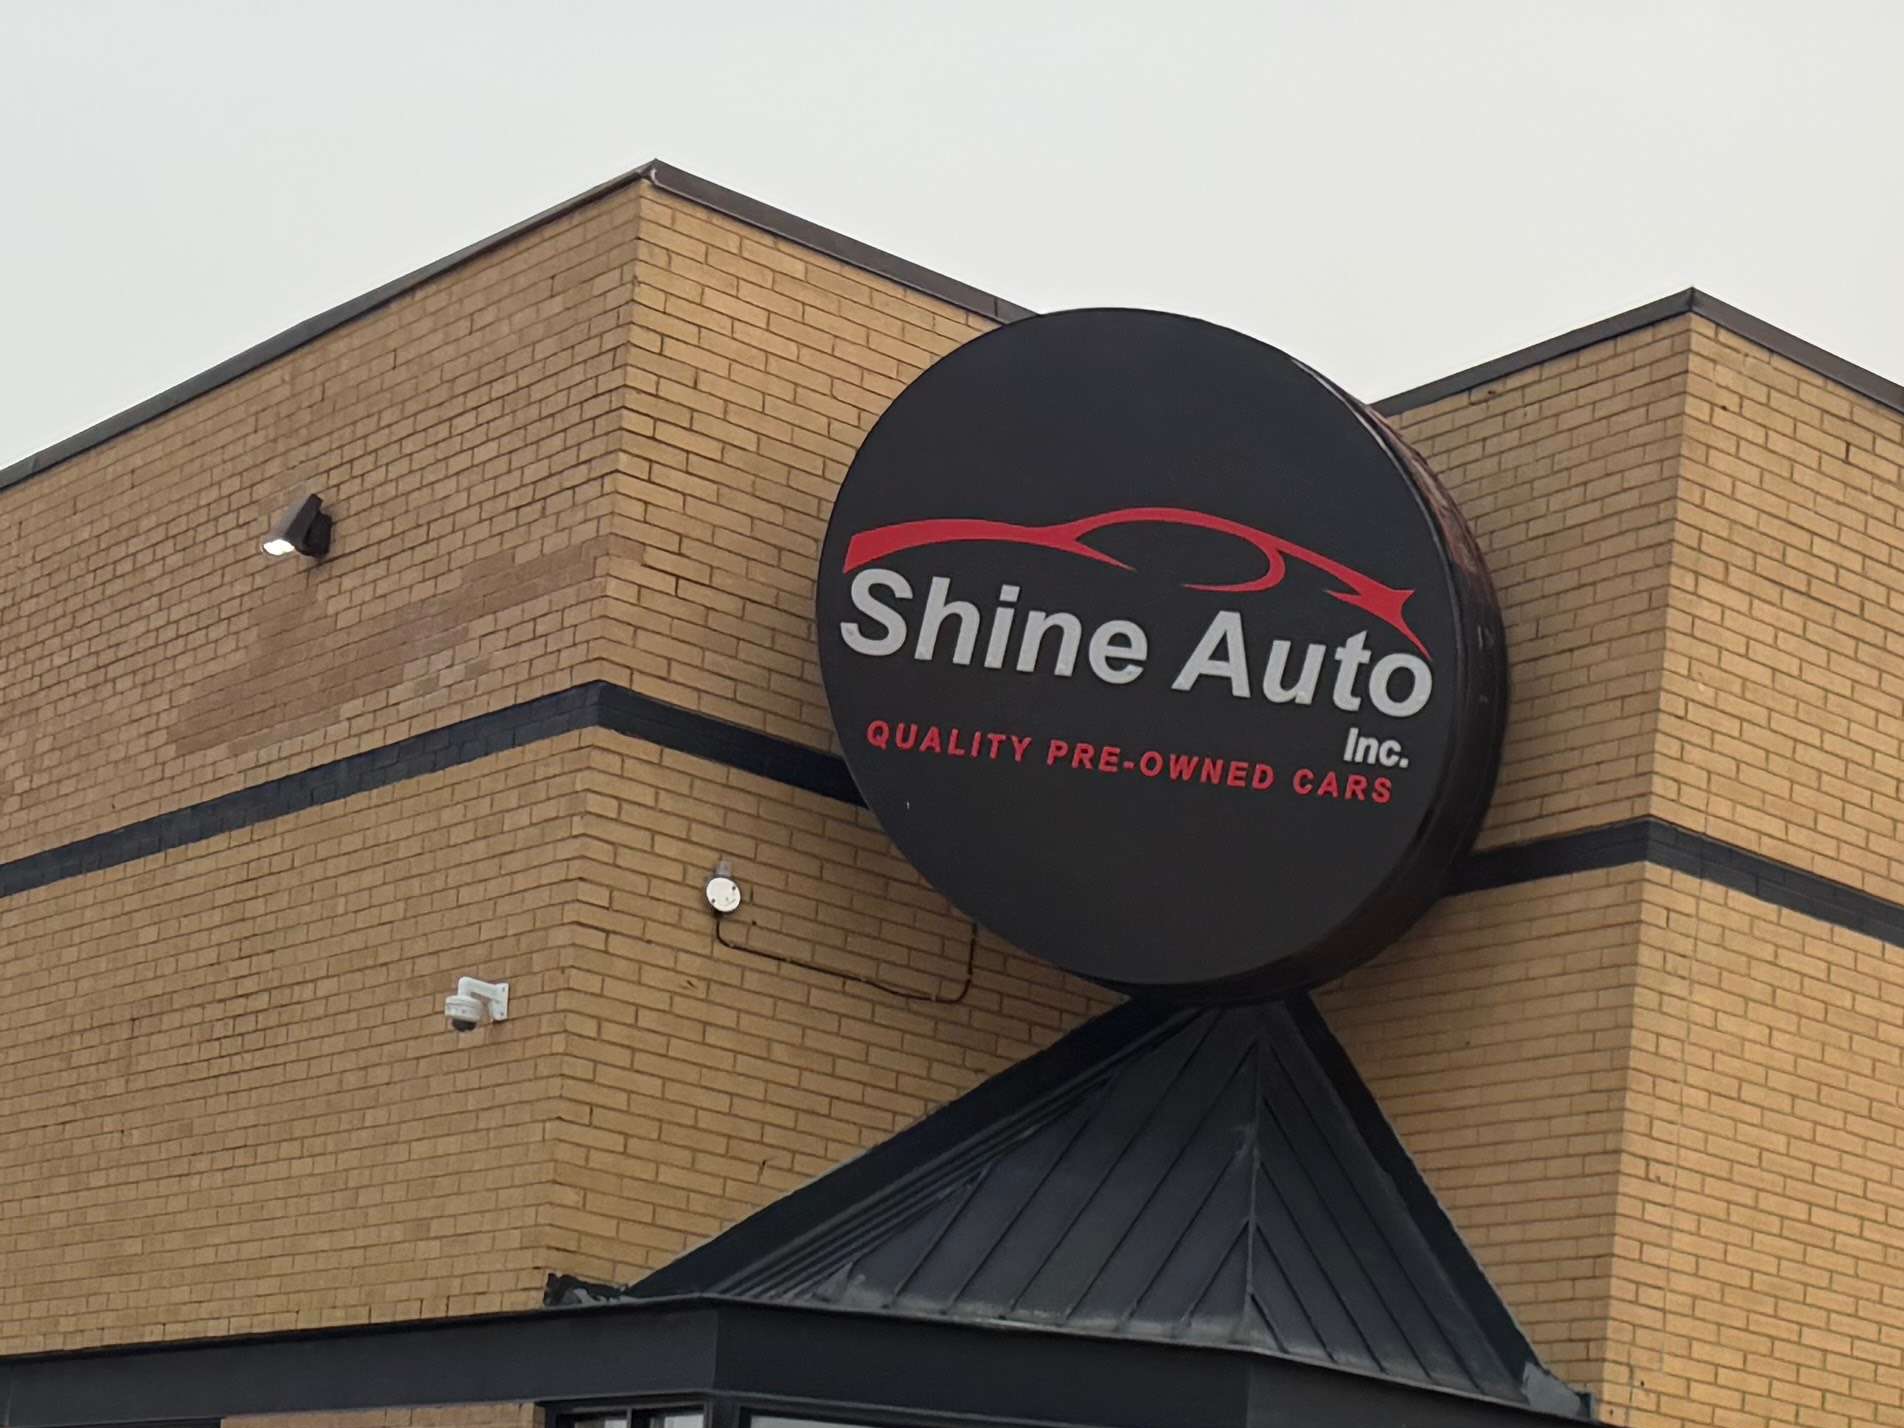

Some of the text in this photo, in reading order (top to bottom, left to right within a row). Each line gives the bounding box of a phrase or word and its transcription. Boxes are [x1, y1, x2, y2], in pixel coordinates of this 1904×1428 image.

[839, 567, 1433, 717] Shine Auto
[865, 720, 1393, 804] QUALITY PRE-OWNED CARS
[1343, 727, 1410, 769] Inc.
